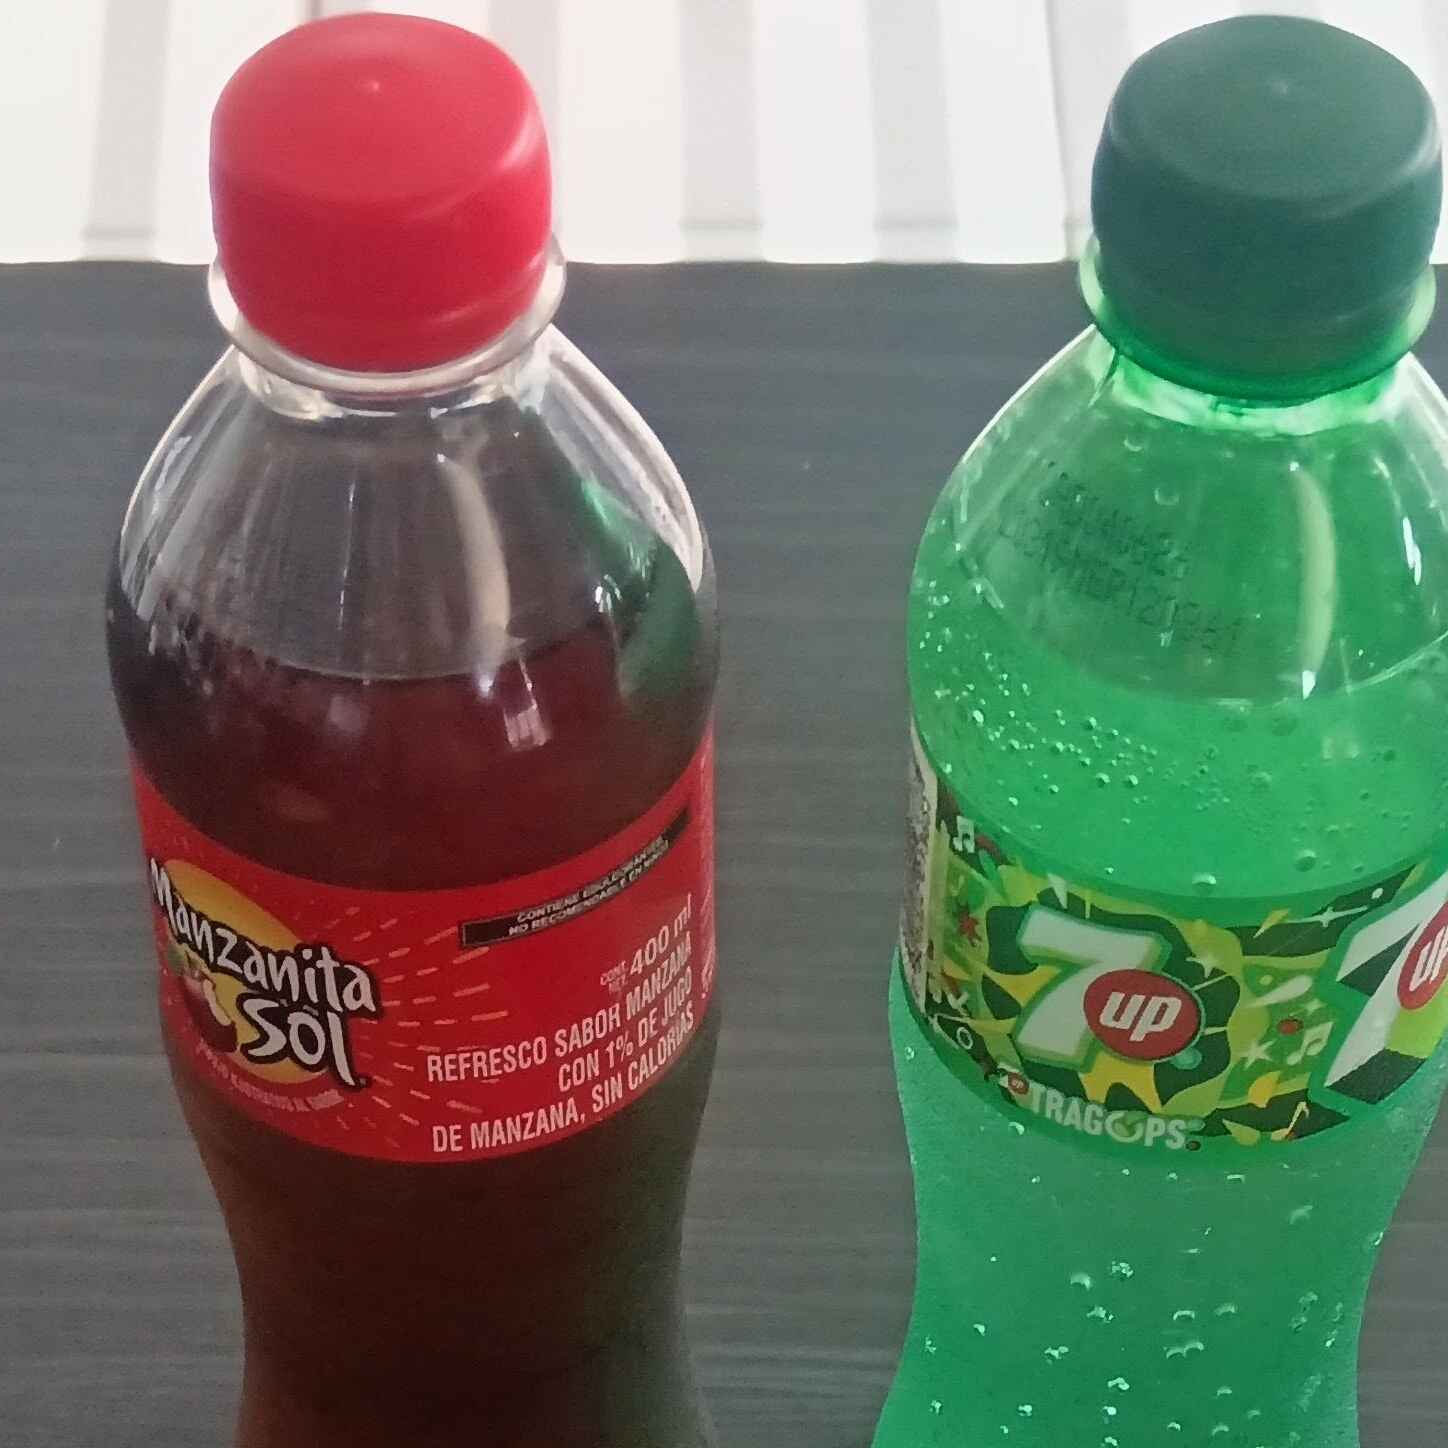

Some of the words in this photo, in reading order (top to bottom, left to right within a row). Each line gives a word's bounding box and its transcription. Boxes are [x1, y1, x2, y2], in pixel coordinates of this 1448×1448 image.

[149, 857, 377, 1013] Manzanita
[630, 926, 670, 976] 400
[673, 892, 693, 938] ml
[427, 1036, 548, 1082] REFRESCO
[554, 1003, 621, 1058] SABOR
[626, 931, 692, 1021] MANZANA
[558, 1047, 600, 1092] CON
[605, 1030, 634, 1069] 1%
[638, 1007, 658, 1049] DE
[660, 965, 693, 1027] JUGO
[432, 1125, 463, 1153] DE
[470, 1097, 587, 1150] MANZANA,
[592, 1076, 624, 1114] SIN
